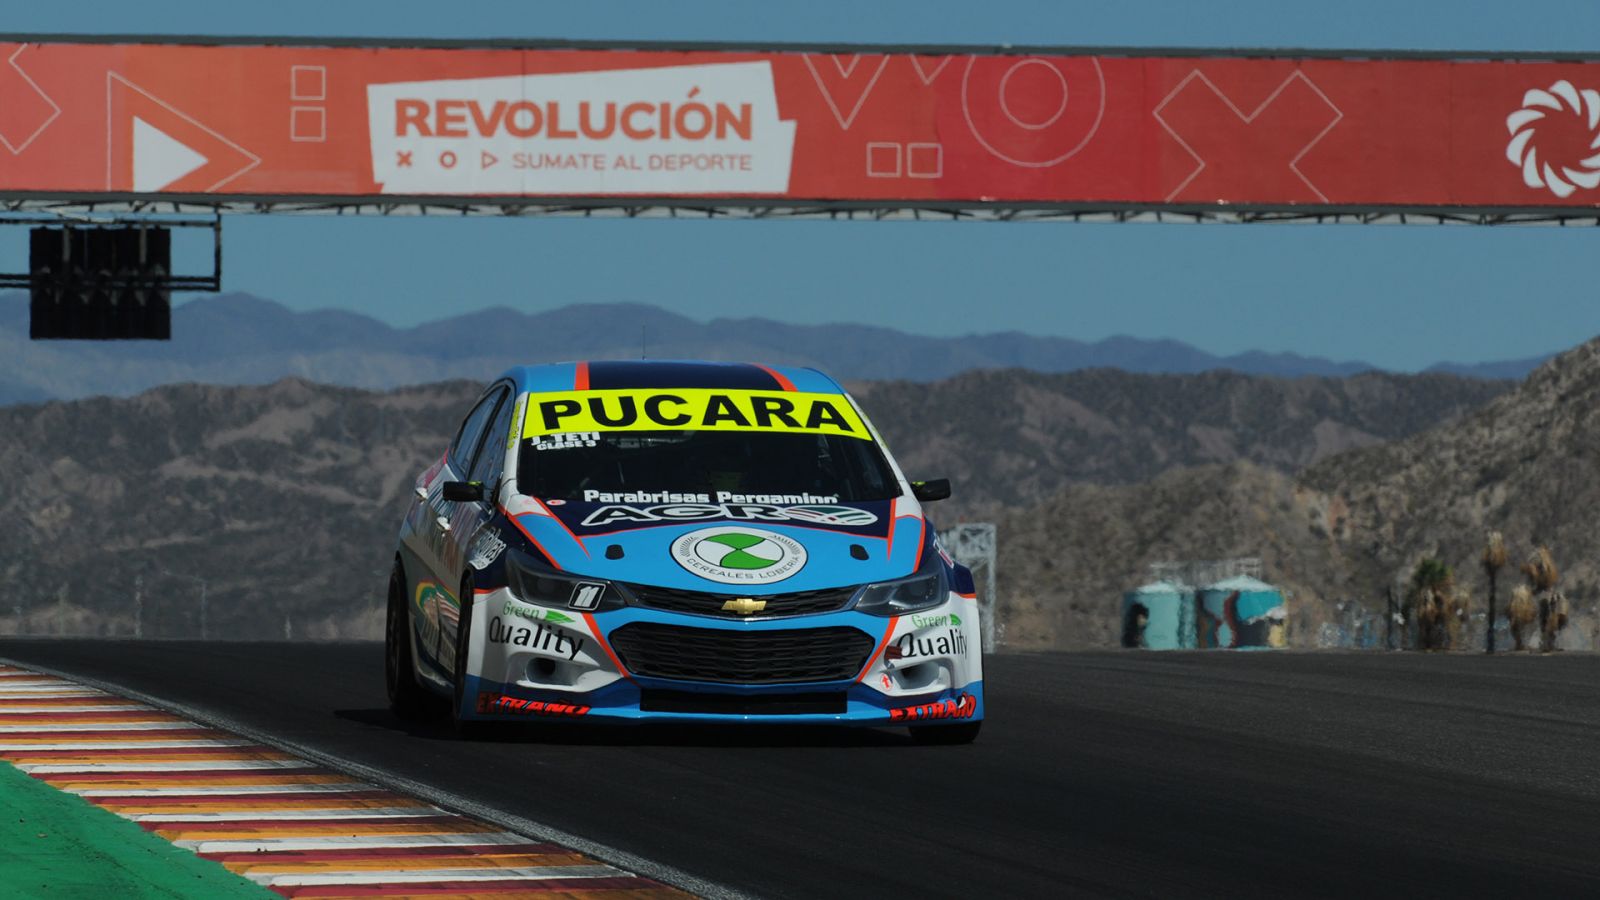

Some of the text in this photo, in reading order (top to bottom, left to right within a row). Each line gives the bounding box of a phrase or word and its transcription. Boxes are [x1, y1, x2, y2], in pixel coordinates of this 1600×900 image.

[395, 86, 752, 141] REVOLUCIÓN
[513, 153, 752, 171] SUMATE AL DEPORTE
[539, 394, 855, 433] PUCARA
[536, 440, 597, 451] CLASE 3
[583, 489, 710, 504] Parabrisas
[686, 558, 754, 580] CEREALES
[502, 600, 540, 620] Green
[912, 614, 947, 629] Green
[488, 616, 584, 662] Quality
[897, 628, 968, 659] Quality
